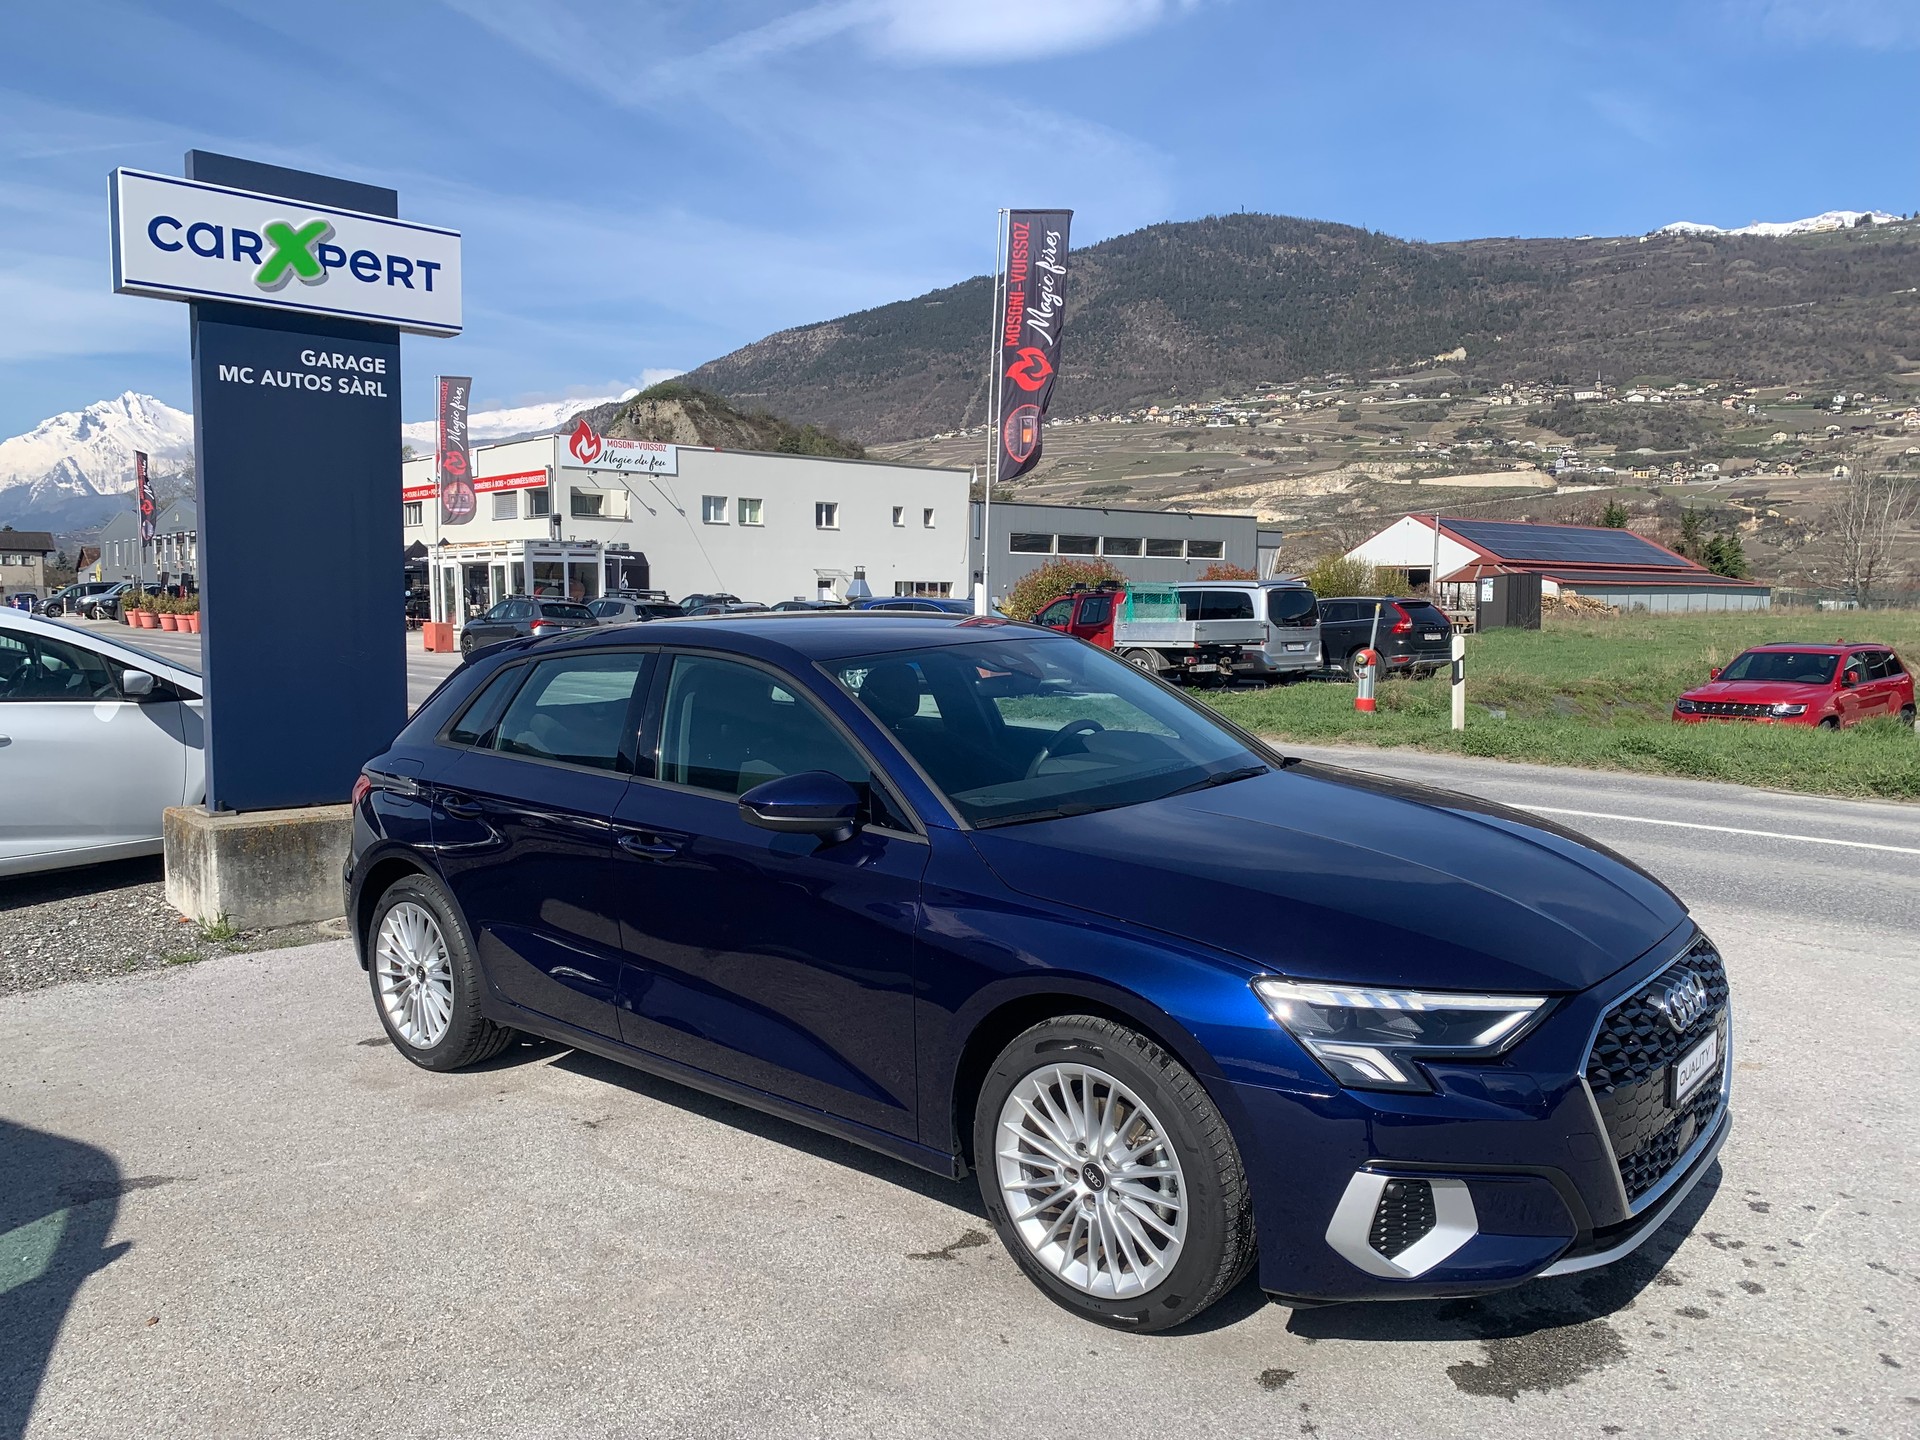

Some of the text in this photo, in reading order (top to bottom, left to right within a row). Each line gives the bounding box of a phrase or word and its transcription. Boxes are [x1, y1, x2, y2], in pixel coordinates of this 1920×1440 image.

[1005, 221, 1030, 347] MOSONI-VUISSOZ
[1026, 230, 1066, 346] Magic fires
[301, 350, 386, 374] GARAGE
[219, 364, 254, 385] MC
[261, 368, 333, 392] AUTOS
[606, 440, 667, 452] MOSONI-VUISSOZ
[594, 450, 666, 471] Magie du feu
